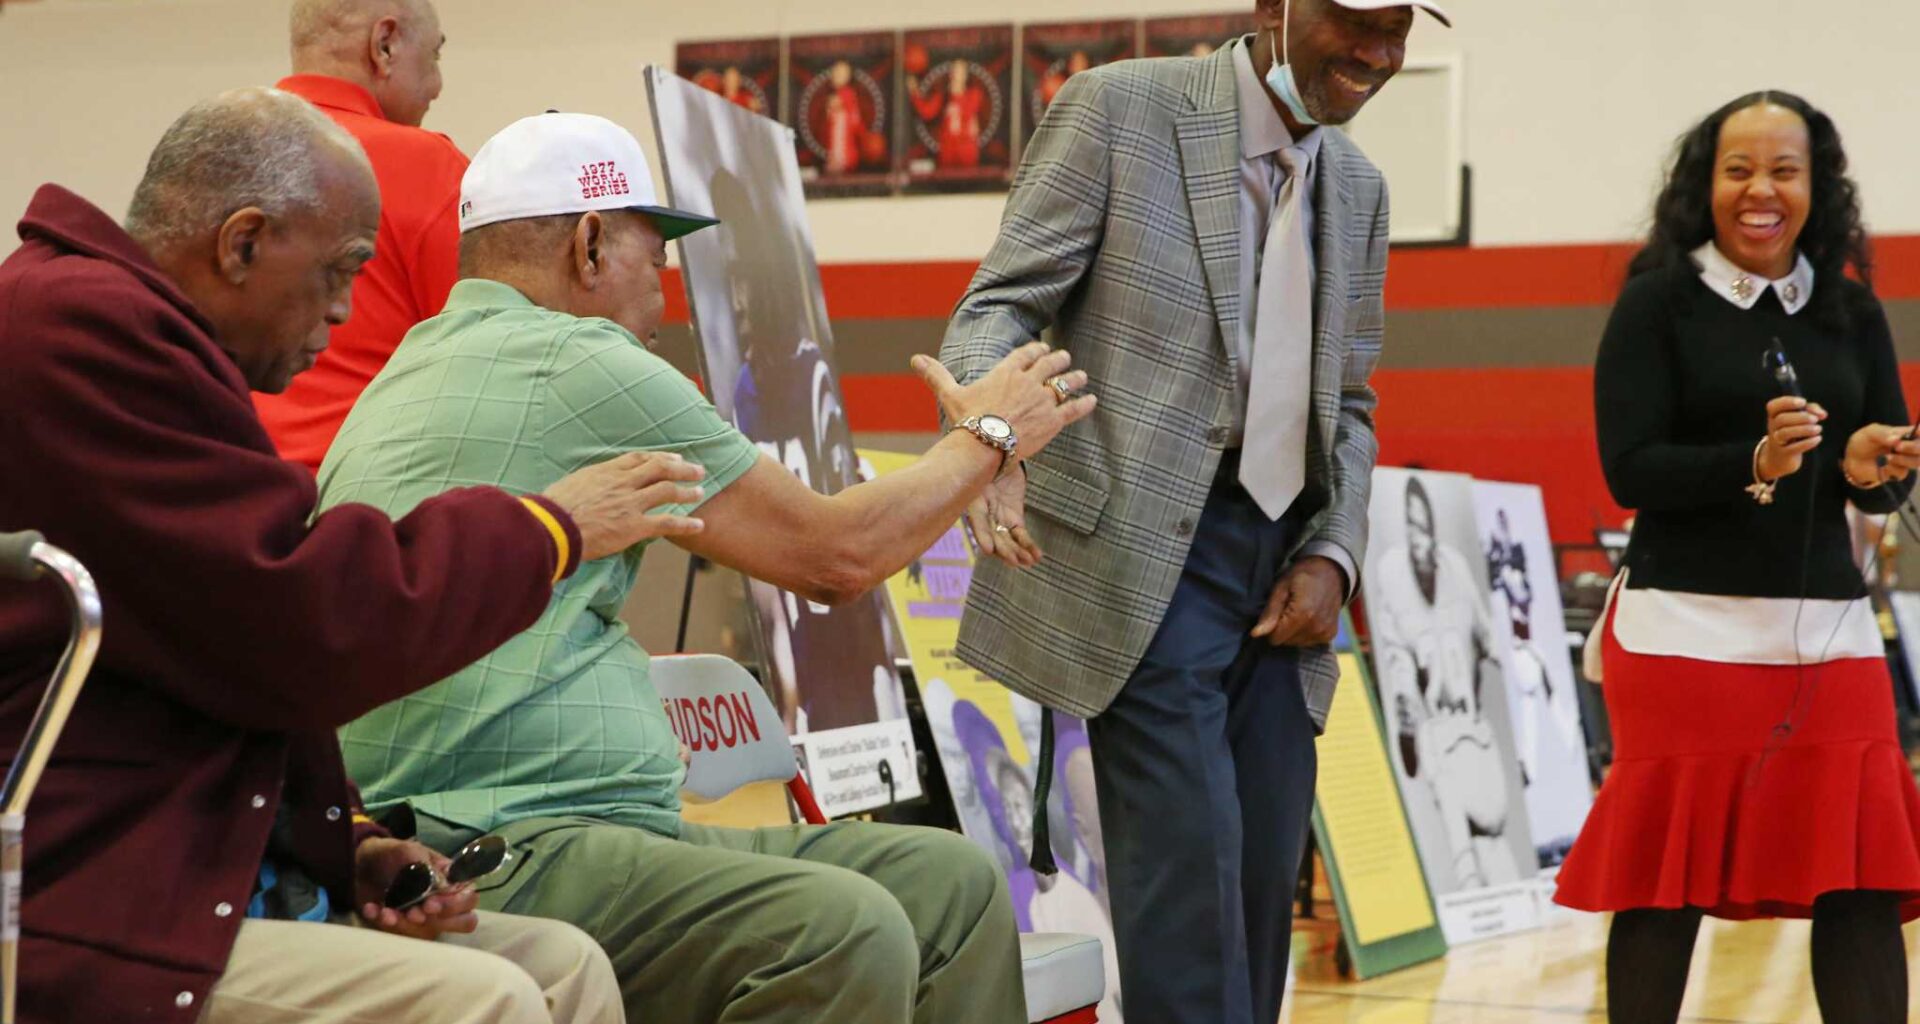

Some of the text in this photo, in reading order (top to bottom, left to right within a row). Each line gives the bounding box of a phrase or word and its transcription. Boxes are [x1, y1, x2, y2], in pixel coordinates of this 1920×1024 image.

[582, 161, 615, 175] 1977
[578, 172, 626, 187] WORLD
[582, 184, 630, 199] SERIES
[661, 691, 761, 752] UDSON
